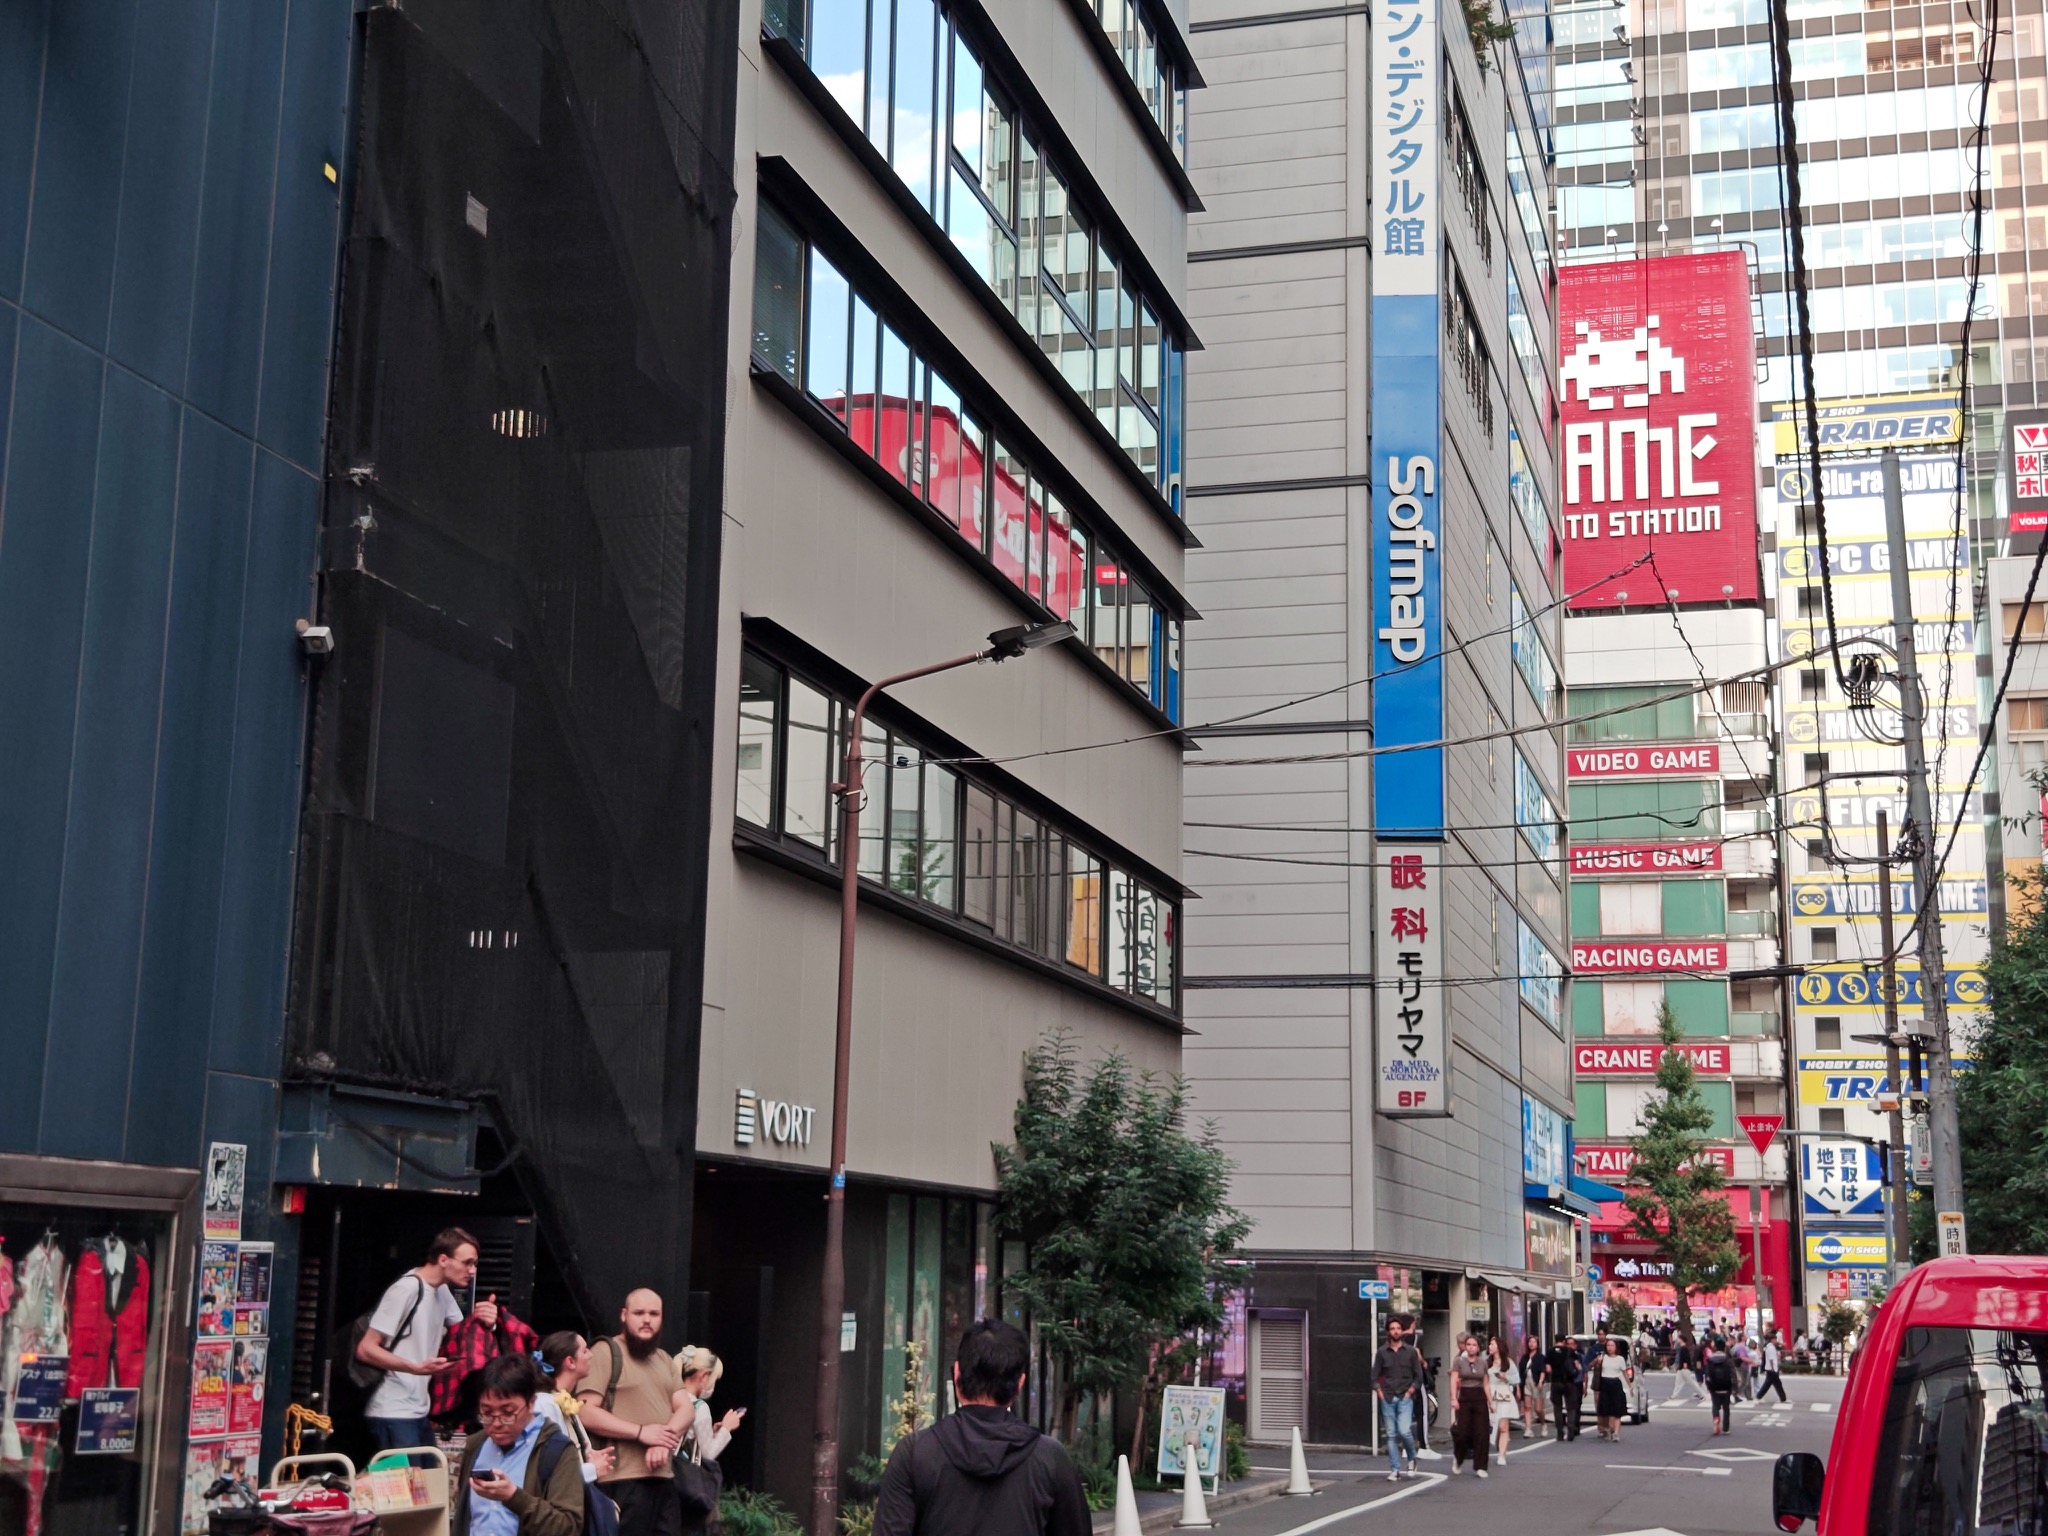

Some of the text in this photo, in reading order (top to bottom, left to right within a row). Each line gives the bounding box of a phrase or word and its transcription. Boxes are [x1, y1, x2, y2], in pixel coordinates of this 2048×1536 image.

[1384, 0, 1425, 256] ン・デジタル館
[1829, 406, 1866, 417] SHOP
[1561, 413, 1720, 505] AME
[2017, 454, 2048, 475] 秋
[1820, 461, 1956, 497] Blu-ra&DVD
[1609, 505, 1721, 538] STATION
[2019, 516, 2048, 526] VOLK
[1379, 455, 1436, 662] Sofmap
[1826, 545, 1862, 573] PC
[1576, 750, 1711, 772] VIDEO GAME
[1576, 847, 1714, 869] MUSIC GAME
[1573, 947, 1719, 968] RACING GAME
[1579, 1049, 1653, 1068] CRANE
[1805, 1060, 1888, 1070] HOBBY SHO
[758, 1098, 816, 1144] VORT
[1747, 1122, 1775, 1132] 止まれ
[1816, 1147, 1836, 1200] 地下へ
[1840, 1147, 1858, 1203] 買取は
[1813, 1245, 1886, 1254] HOBBY SHOP
